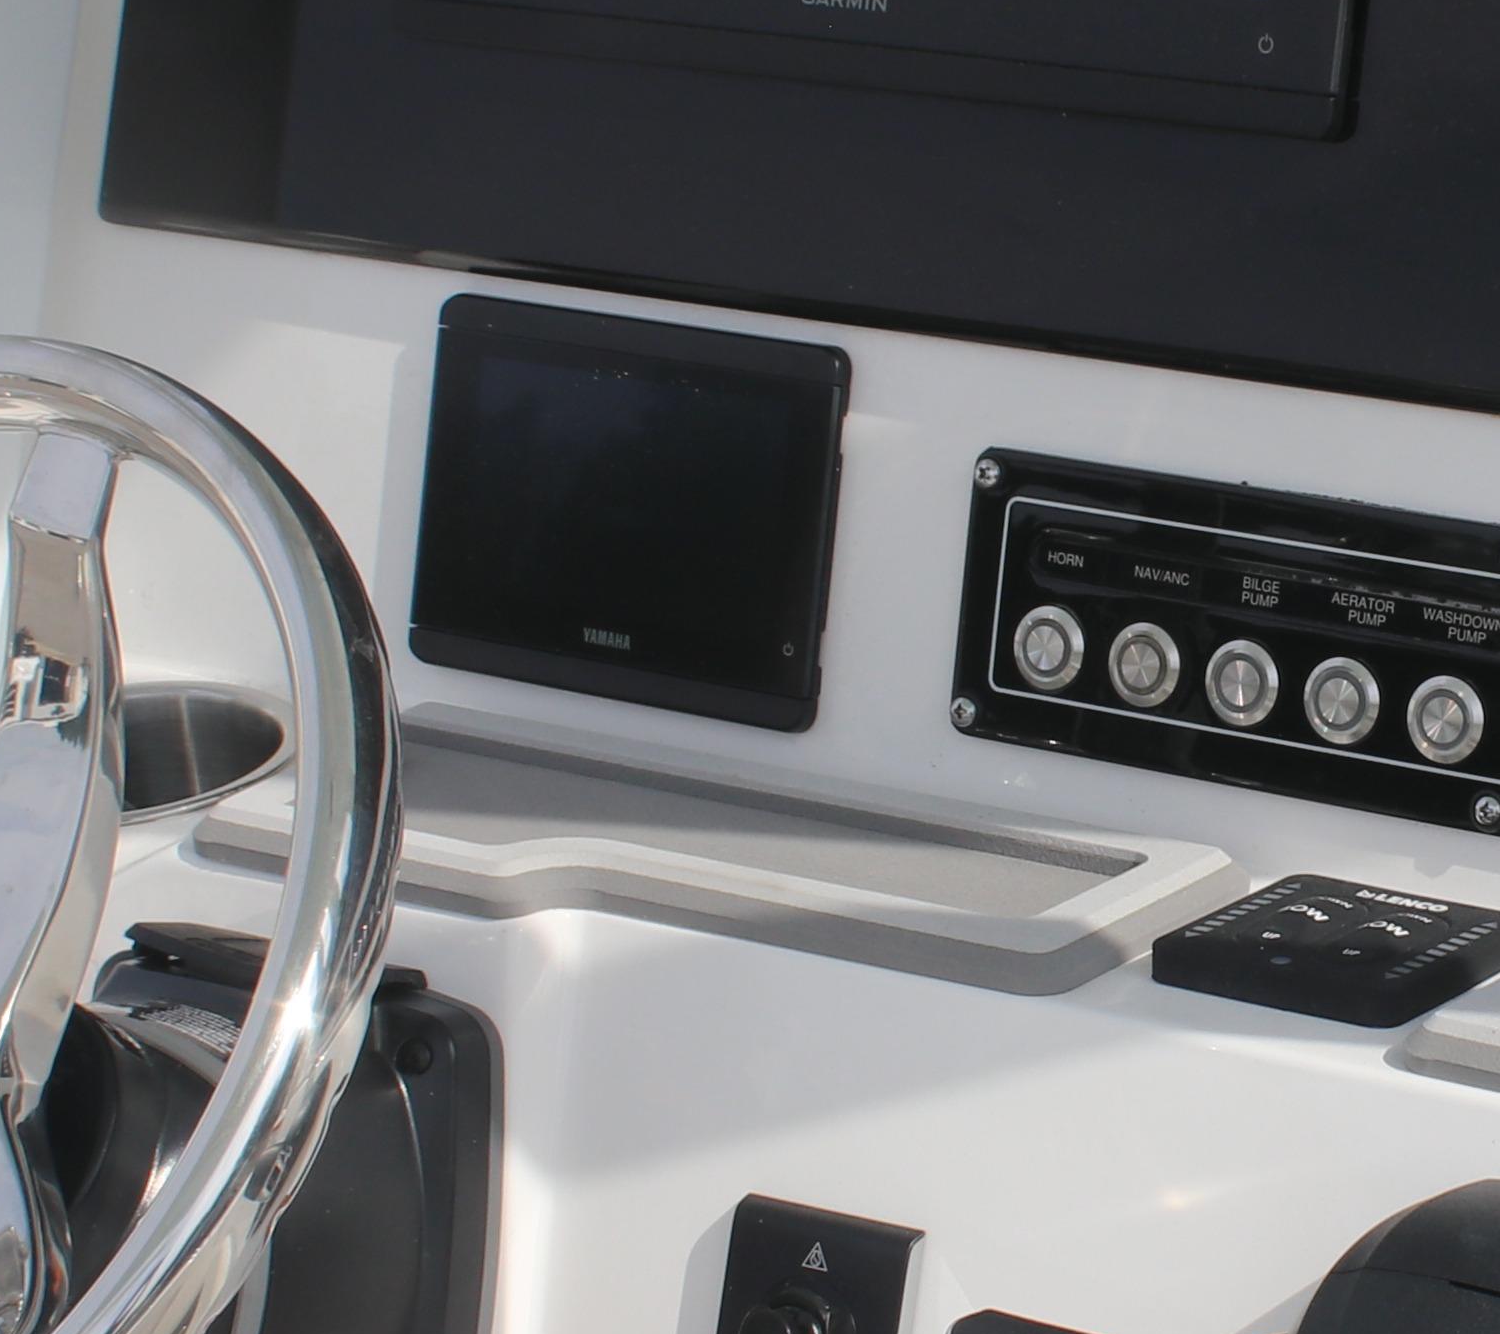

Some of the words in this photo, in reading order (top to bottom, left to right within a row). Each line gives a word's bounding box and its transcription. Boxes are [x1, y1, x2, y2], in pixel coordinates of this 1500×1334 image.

[1047, 550, 1085, 568] HORN
[1133, 565, 1190, 587] NAV/ANC
[1242, 576, 1280, 595] BILGE
[1240, 590, 1279, 609] PUMP
[1330, 590, 1396, 615] AERATOR
[1347, 609, 1387, 628] PUMP
[583, 627, 631, 651] YAMAHA
[1447, 625, 1487, 645] PUMP
[1373, 893, 1449, 912] LENCO
[1261, 931, 1281, 939] UP
